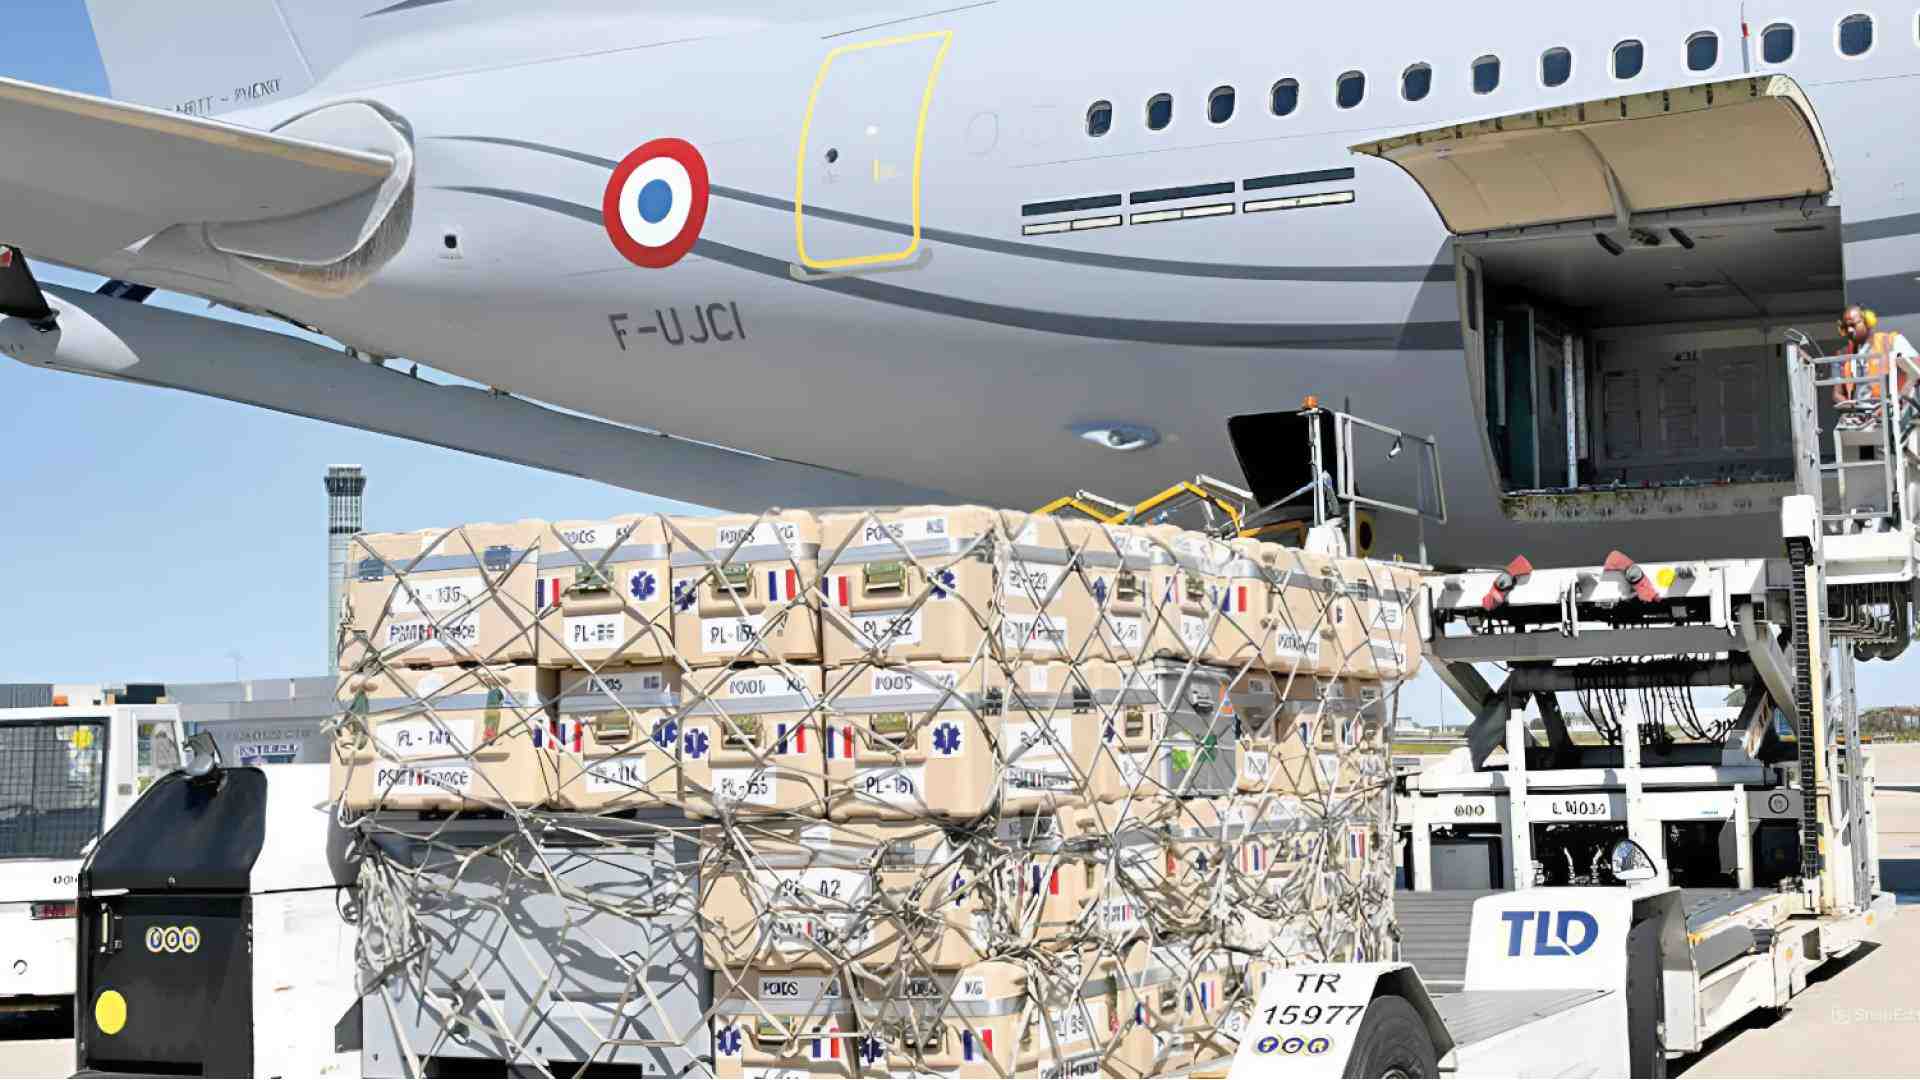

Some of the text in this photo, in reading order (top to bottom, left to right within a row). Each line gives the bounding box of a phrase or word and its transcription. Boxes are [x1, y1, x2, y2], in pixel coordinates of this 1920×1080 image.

[607, 301, 746, 351] F-UJCI
[1502, 910, 1599, 956] TLD
[1296, 973, 1342, 993] TR
[1263, 1004, 1365, 1026] 15977
